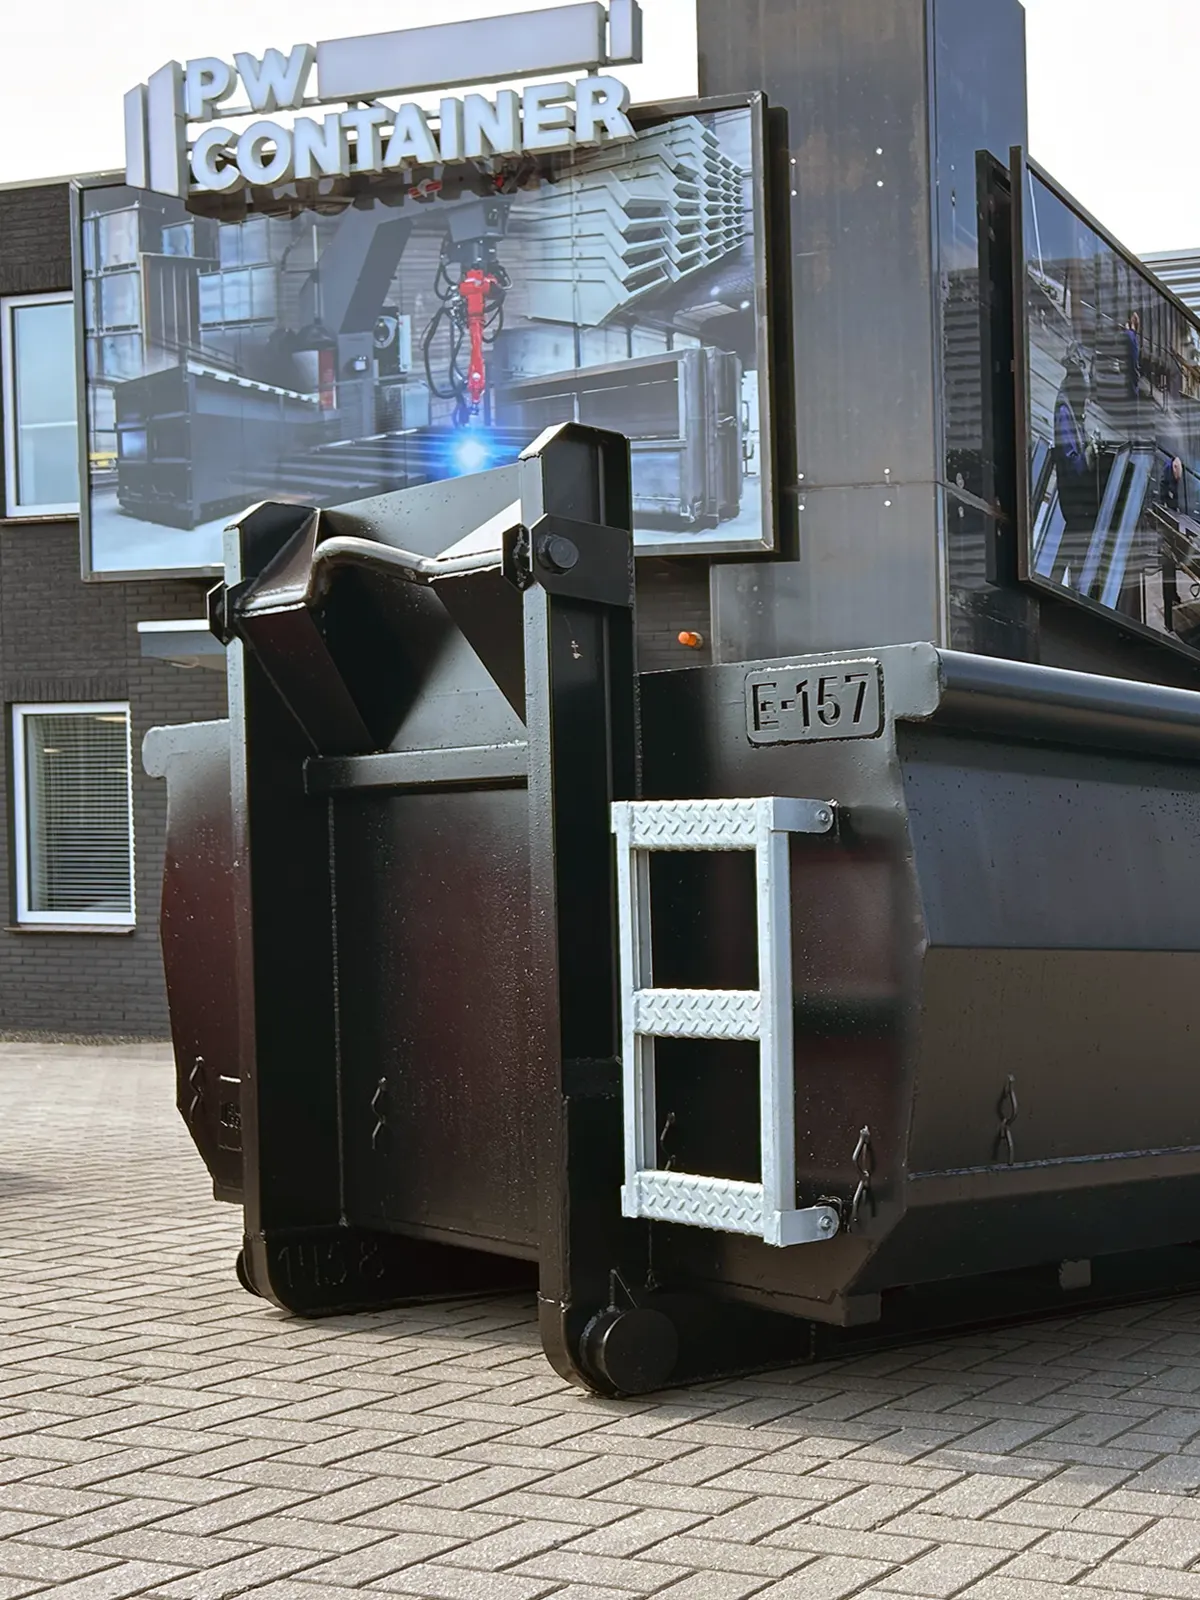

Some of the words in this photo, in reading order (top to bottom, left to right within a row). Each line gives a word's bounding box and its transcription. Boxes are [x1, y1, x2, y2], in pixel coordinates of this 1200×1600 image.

[185, 43, 315, 121] PW
[191, 75, 636, 193] CONTAINER
[752, 673, 869, 733] E-157
